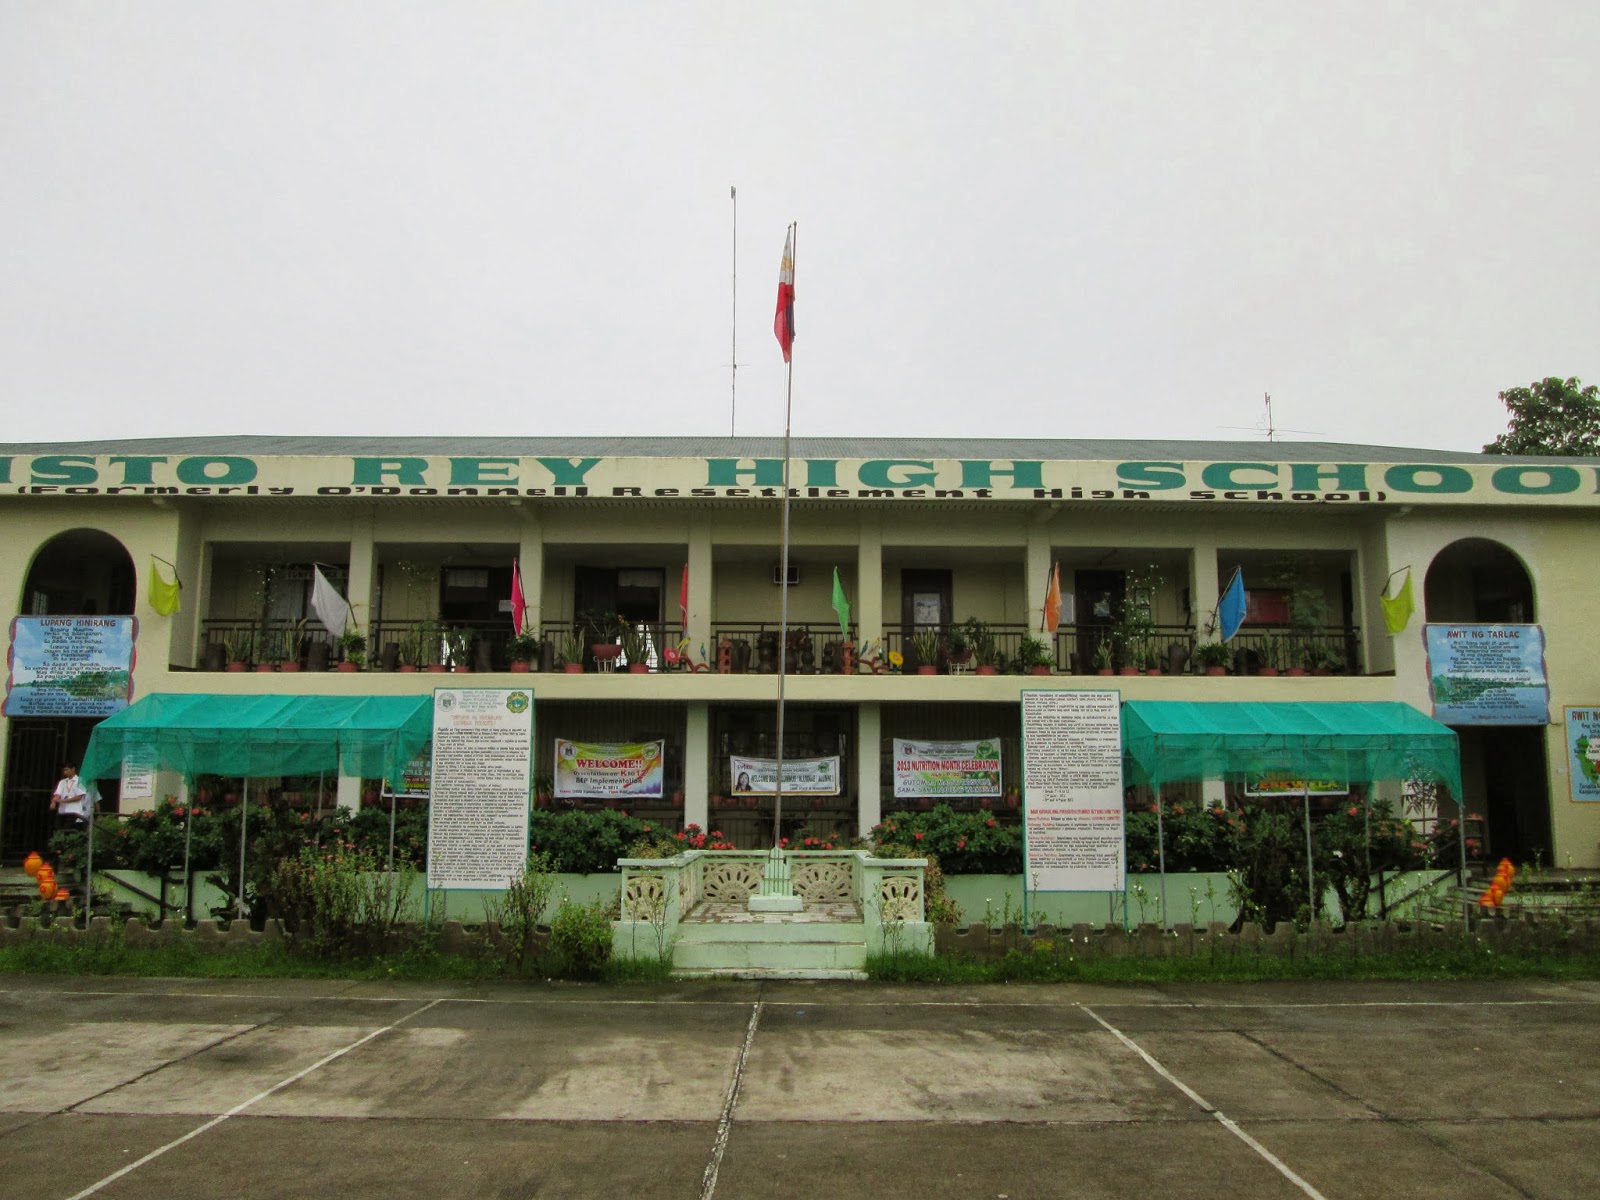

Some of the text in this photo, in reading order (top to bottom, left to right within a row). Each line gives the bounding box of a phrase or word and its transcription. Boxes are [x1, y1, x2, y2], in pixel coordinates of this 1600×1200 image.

[350, 457, 604, 486] REY
[705, 458, 1047, 488] HIGH
[1115, 461, 1600, 496] SCHOO
[18, 486, 1387, 502] (Formerly O'Donnell Resettlement High School)
[1572, 711, 1600, 720] AWIT N
[576, 759, 642, 768] WELCOME!!
[897, 760, 998, 771] 2013 NUTRITION MONTH CELEBRATION
